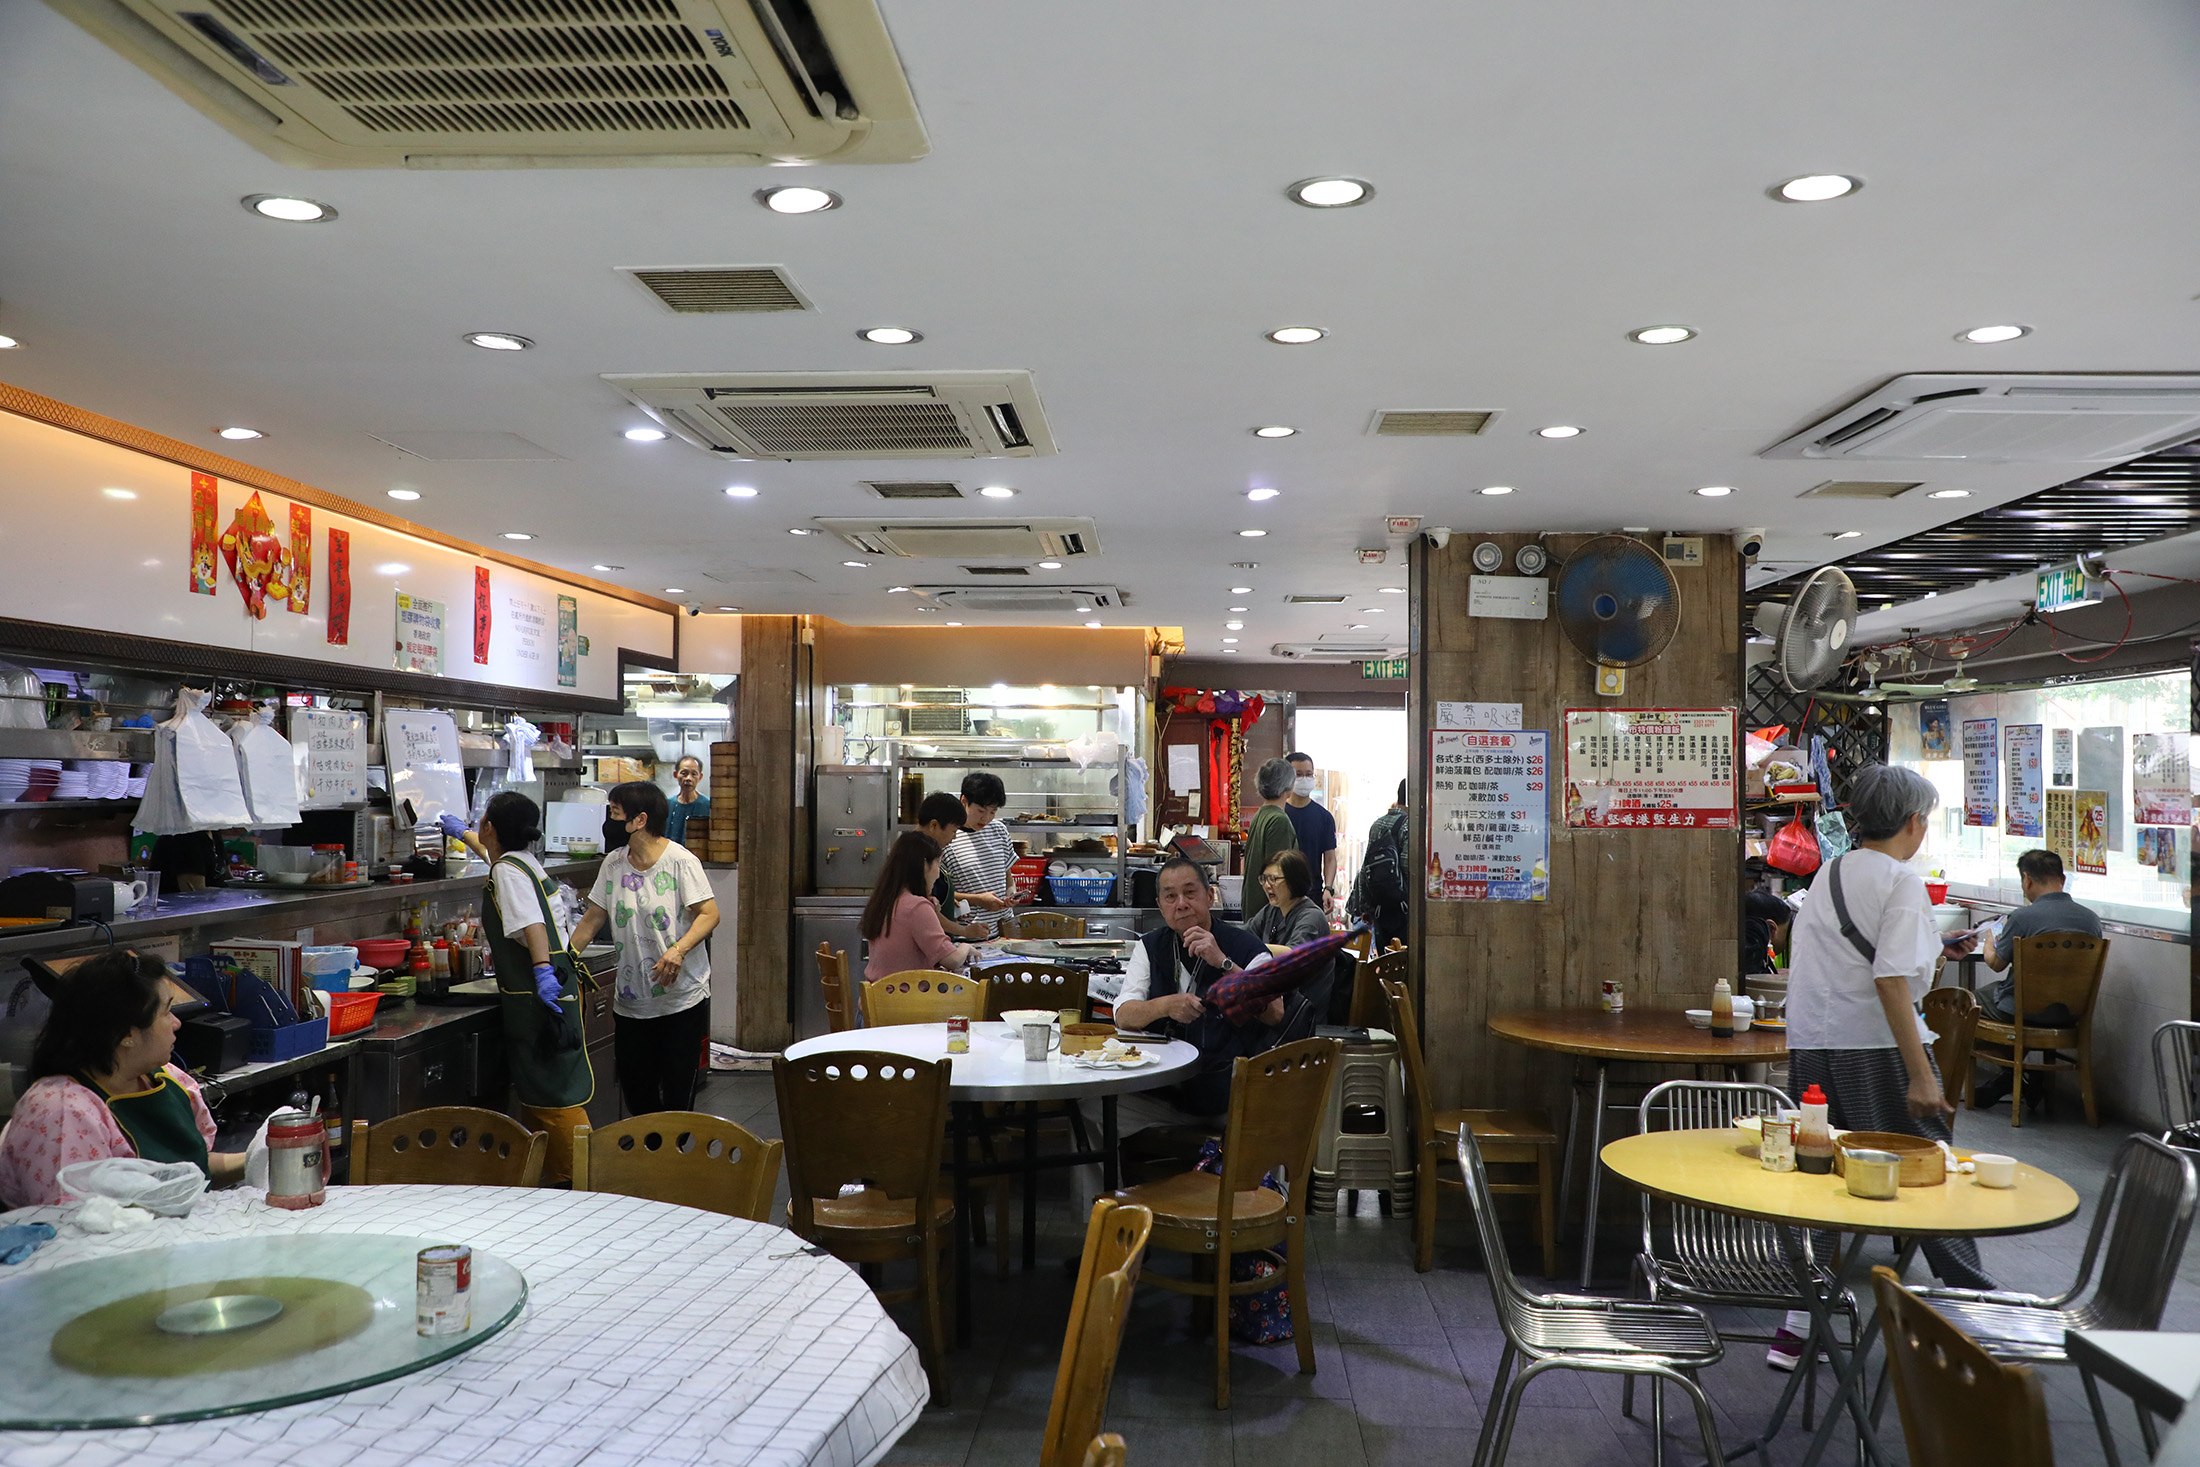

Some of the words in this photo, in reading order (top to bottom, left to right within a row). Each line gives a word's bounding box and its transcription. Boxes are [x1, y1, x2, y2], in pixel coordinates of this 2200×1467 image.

[709, 36, 737, 58] YORK
[2038, 572, 2062, 609] EXIT
[2062, 567, 2086, 604] 出口
[1364, 660, 1390, 679] EXIT
[1467, 735, 1511, 747] 自選套餐
[1436, 754, 1524, 764] 各式多士(西多士除外)
[1526, 755, 1544, 764] $26
[1435, 766, 1481, 775] 鮮油菠蘿包
[1484, 766, 1523, 776] 配咖啡/茶
[1526, 766, 1544, 776] $26
[1435, 781, 1453, 790] 熱狗
[1526, 782, 1544, 791] $29
[1510, 810, 1527, 819] $31
[1607, 813, 1650, 826] 堅香港
[1653, 813, 1696, 826] 堅生力
[1457, 865, 1487, 873] 生力啤酒
